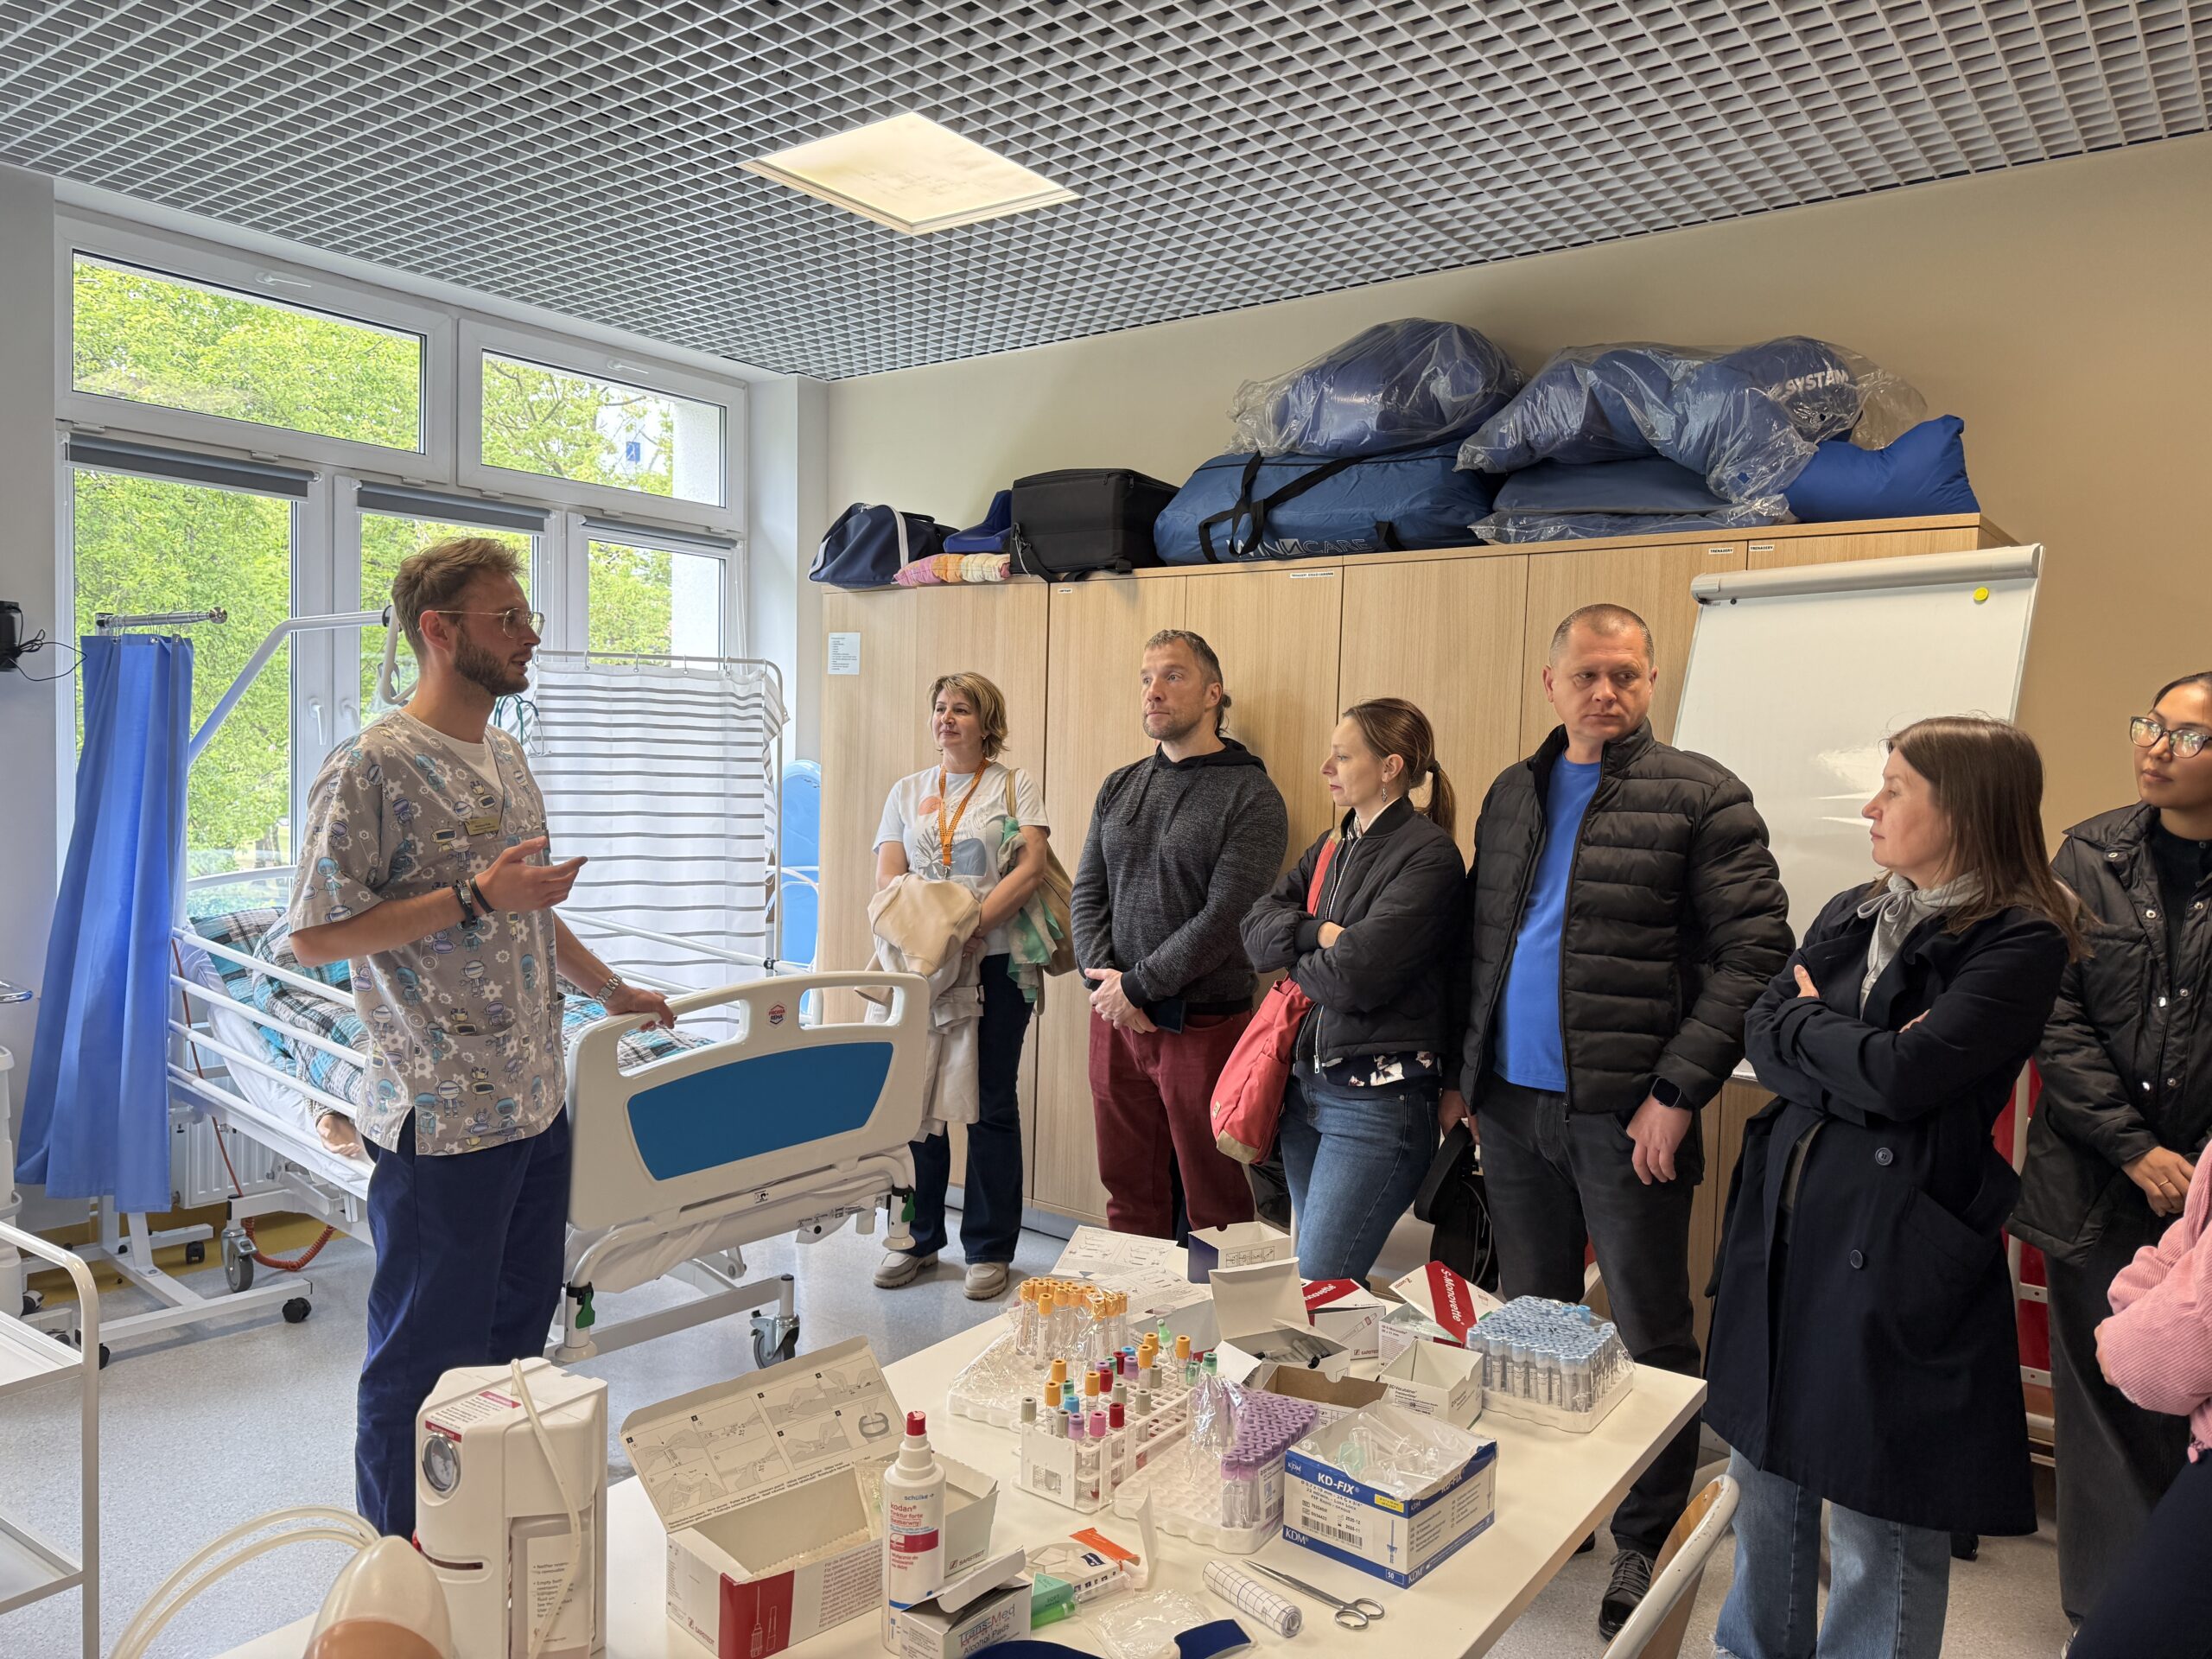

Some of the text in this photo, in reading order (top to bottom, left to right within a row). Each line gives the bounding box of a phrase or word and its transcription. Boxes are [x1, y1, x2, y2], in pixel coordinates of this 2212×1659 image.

[1785, 369, 1849, 396] SYSTAM
[1317, 1471, 1360, 1496] KD-FIX®
[959, 1549, 986, 1566] SARSTEDT
